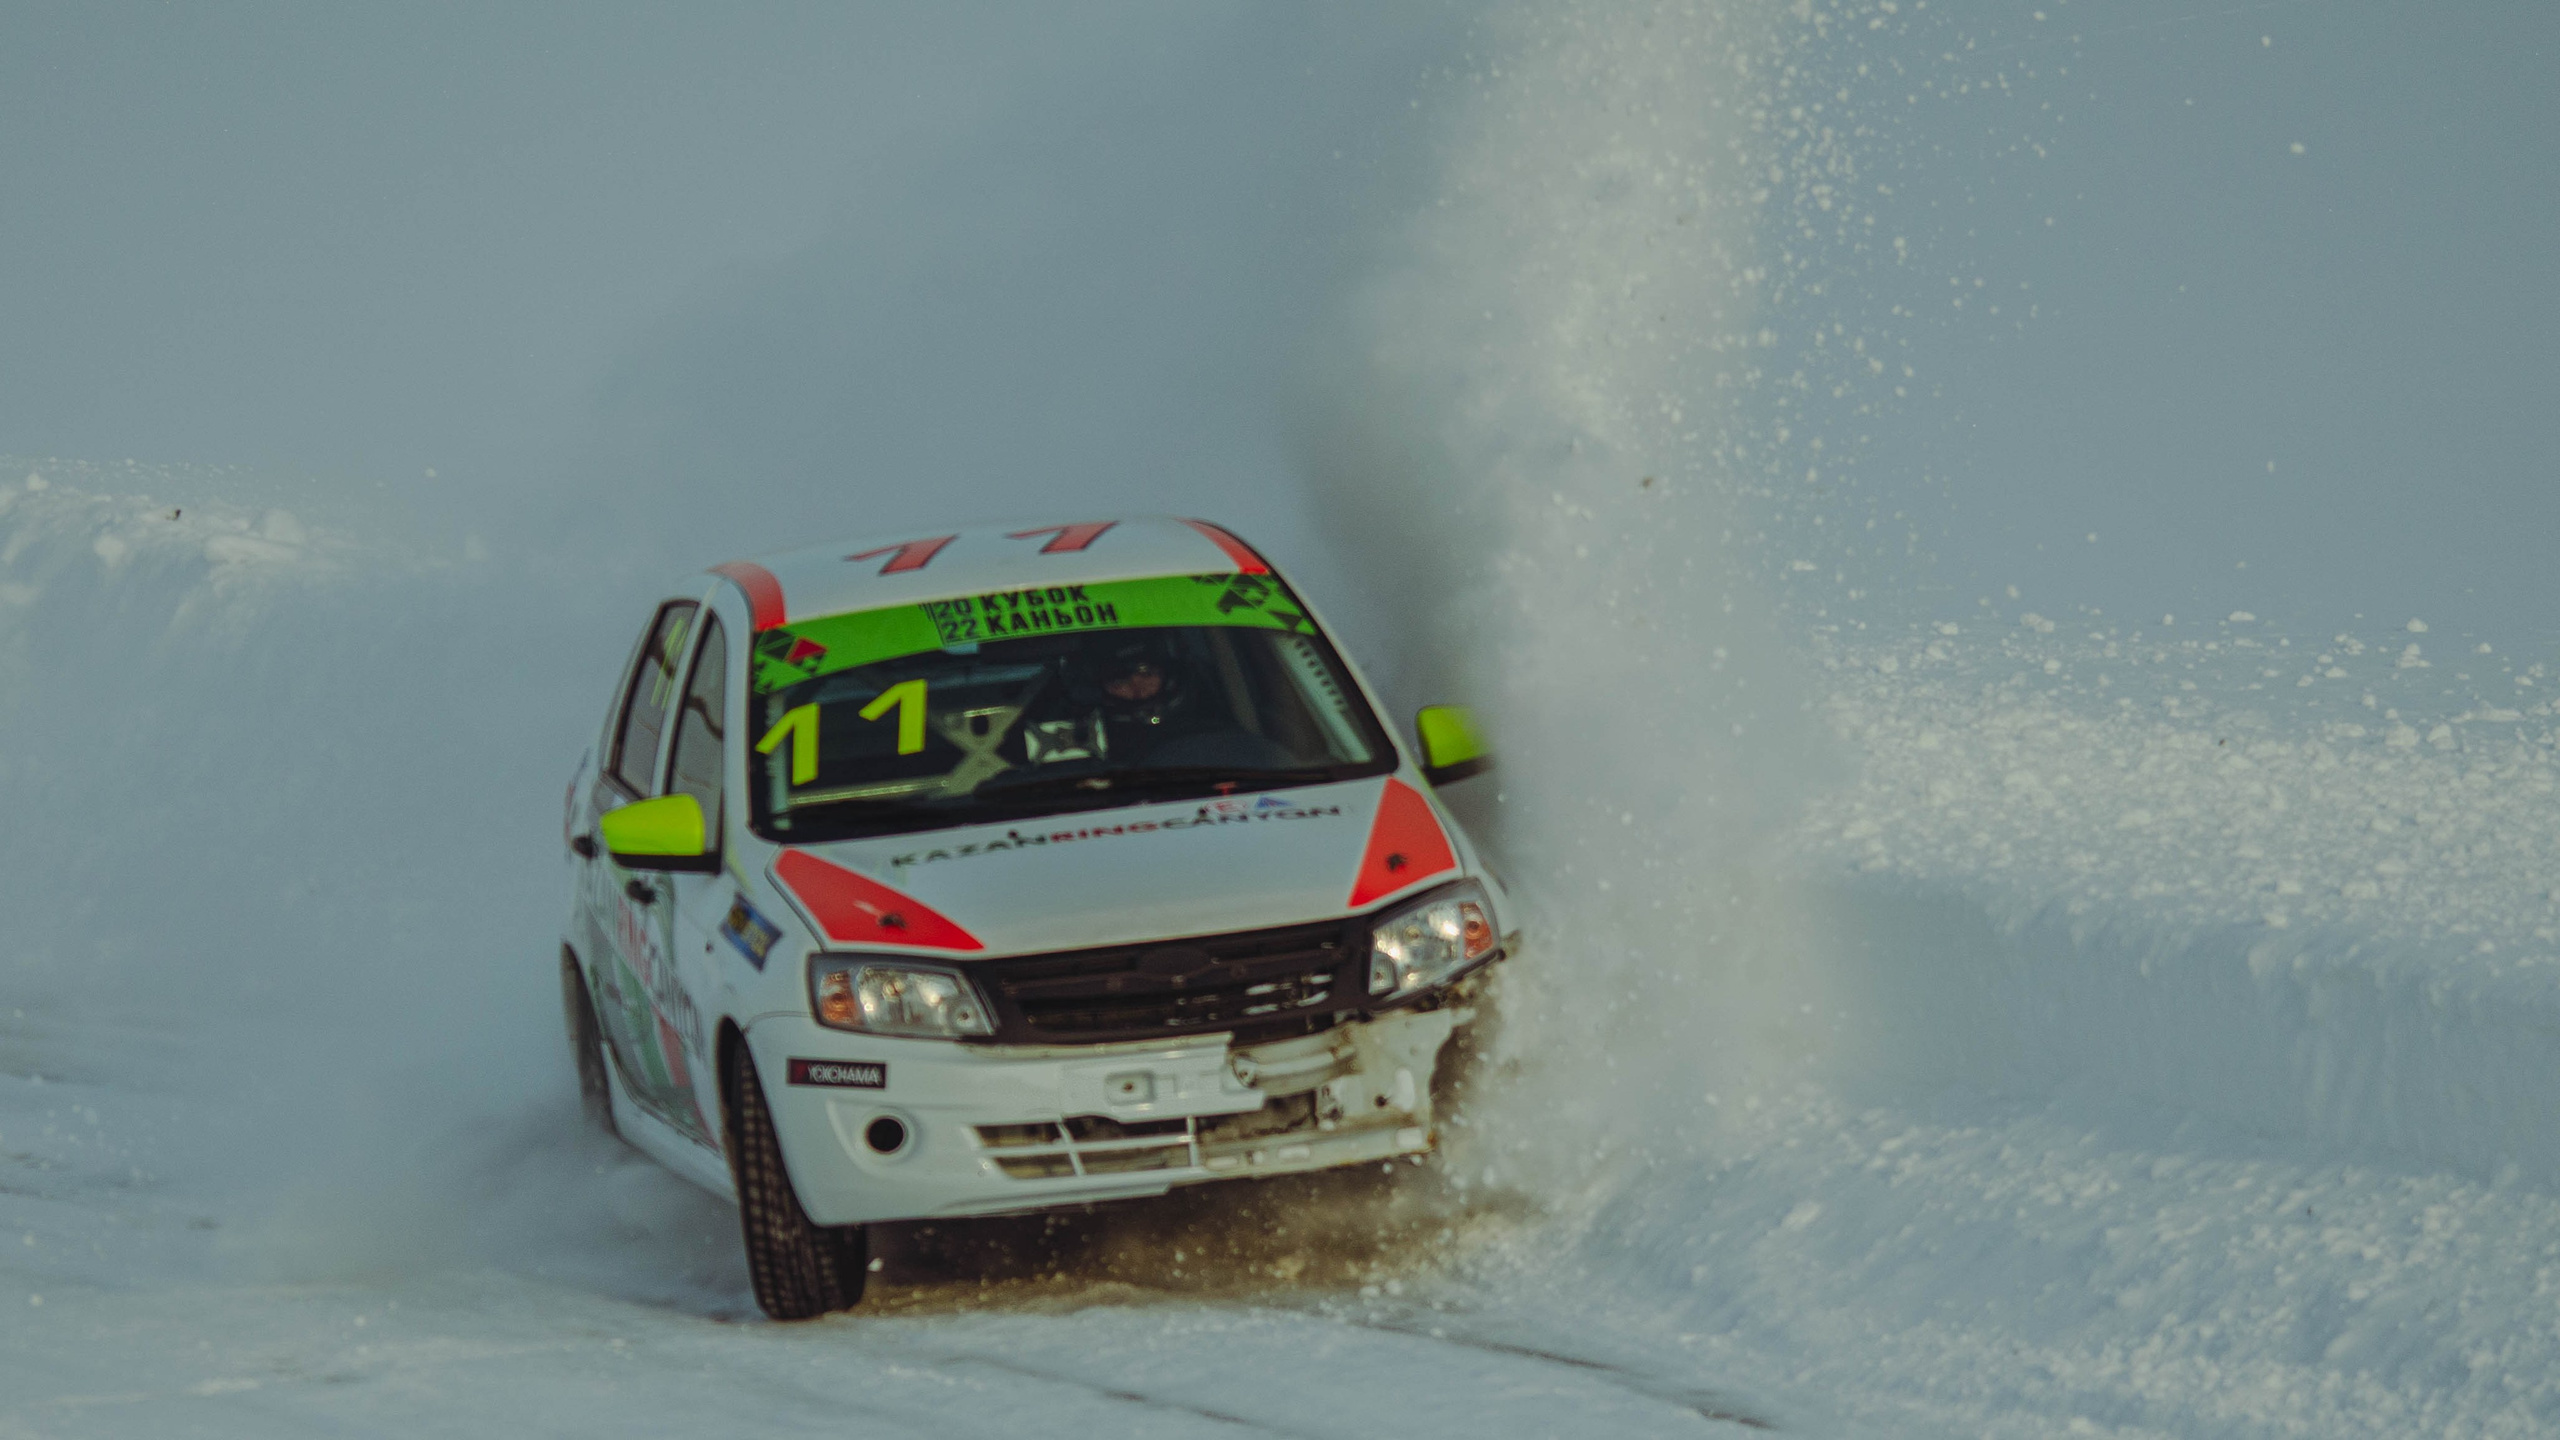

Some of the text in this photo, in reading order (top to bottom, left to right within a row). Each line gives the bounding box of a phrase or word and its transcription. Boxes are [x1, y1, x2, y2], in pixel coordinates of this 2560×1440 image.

[934, 584, 1088, 619] 20 КУБОК
[941, 602, 1118, 641] 22 КАНЬОН
[755, 677, 928, 786] 11
